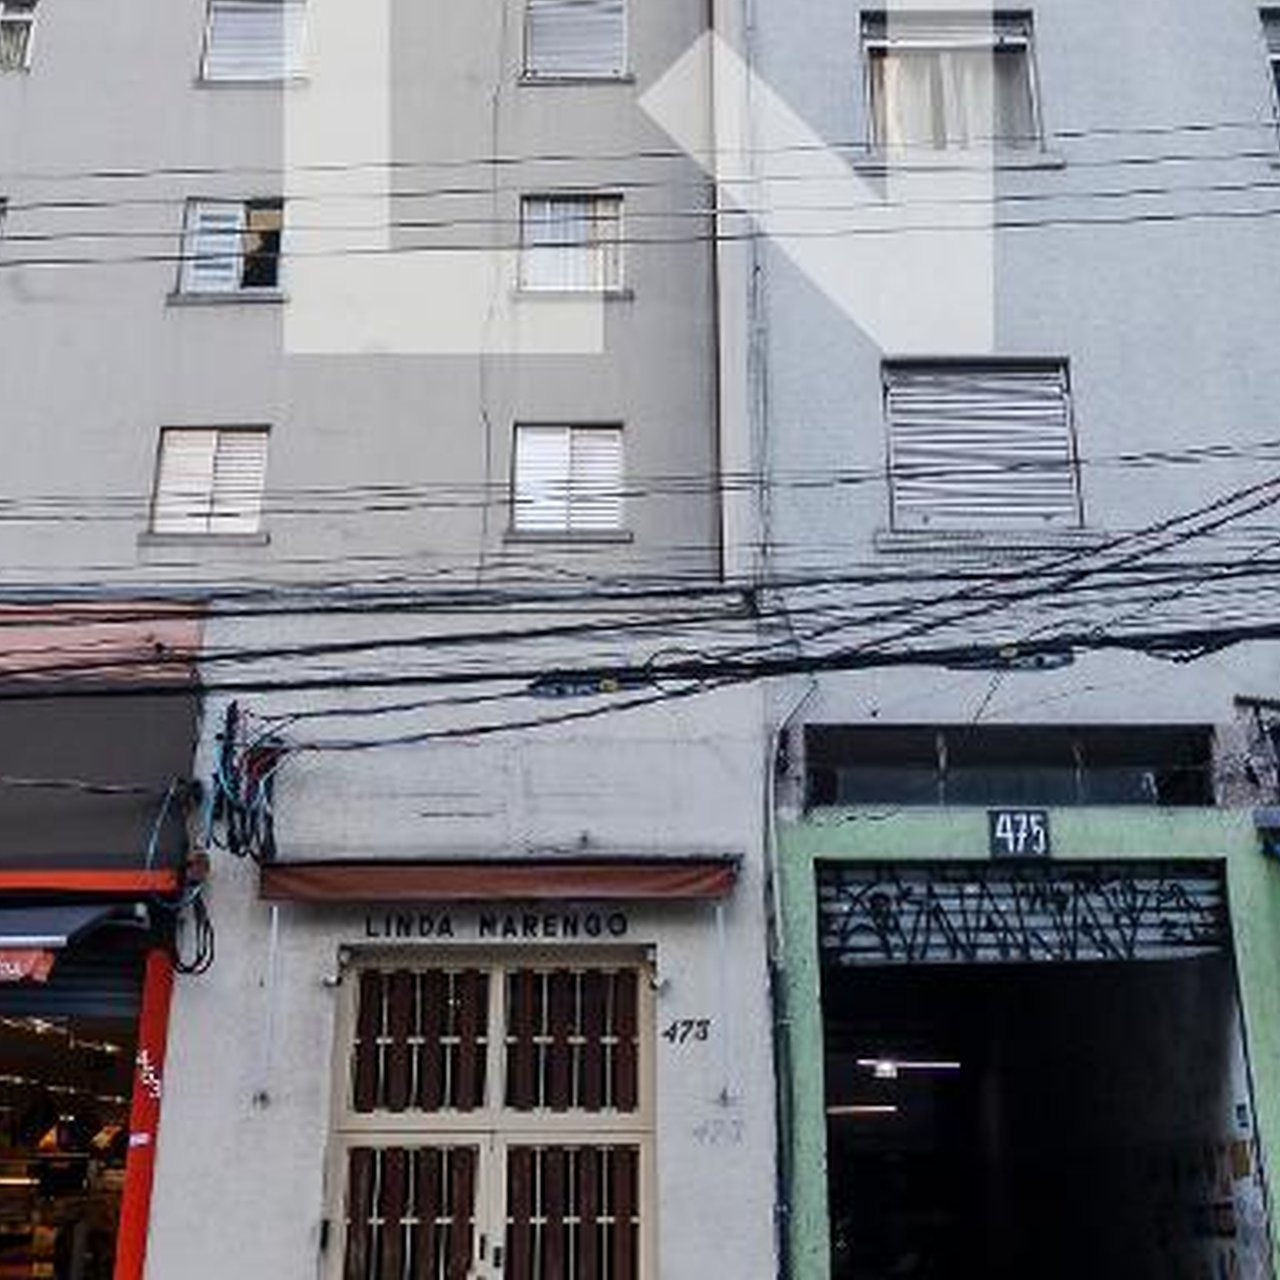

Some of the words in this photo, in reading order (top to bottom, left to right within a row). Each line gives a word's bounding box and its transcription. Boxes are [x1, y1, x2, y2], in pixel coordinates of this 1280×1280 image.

[994, 813, 1047, 854] 475
[365, 912, 455, 938] LINDA
[478, 912, 628, 938] MARENGO
[662, 1019, 712, 1044] 473
